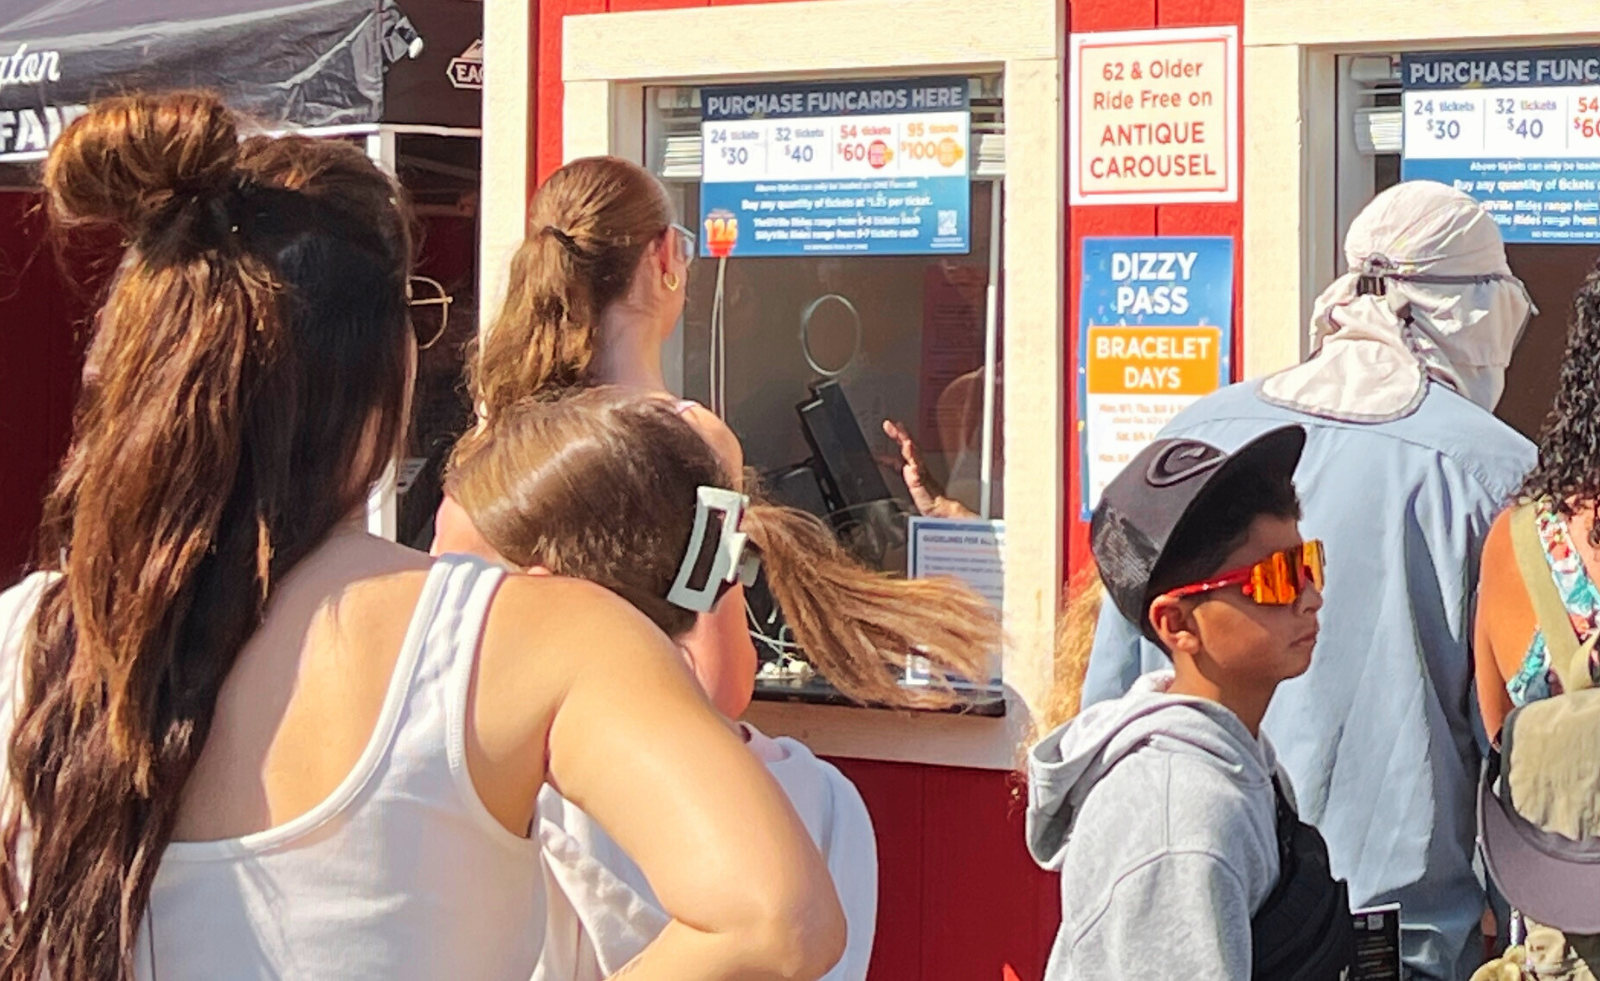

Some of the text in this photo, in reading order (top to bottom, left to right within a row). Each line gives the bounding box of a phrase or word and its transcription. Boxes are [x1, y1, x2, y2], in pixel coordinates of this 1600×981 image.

[1102, 59, 1203, 81] 62 & Older
[1410, 60, 1529, 84] PURCHASE
[708, 87, 963, 115] PURCHASE FUNCARDS HERE
[1093, 90, 1212, 110] Ride Free on
[1414, 100, 1475, 115] 24 tickets
[1495, 98, 1557, 115] 32 tickets
[1578, 96, 1599, 113] 54
[711, 129, 727, 144] 24
[775, 127, 791, 141] 32
[840, 124, 857, 139] 54
[1100, 121, 1205, 147] ANTIQUE
[1426, 119, 1461, 139] $30
[1507, 118, 1544, 139] $40
[721, 146, 748, 165] $30
[785, 144, 814, 162] $40
[837, 142, 865, 161] $60
[1090, 153, 1217, 179] CAROUSEL
[1111, 252, 1198, 281] DIZZY
[1117, 286, 1189, 316] PASS
[1096, 336, 1212, 360] BRACELET
[1124, 366, 1181, 390] DAYS
